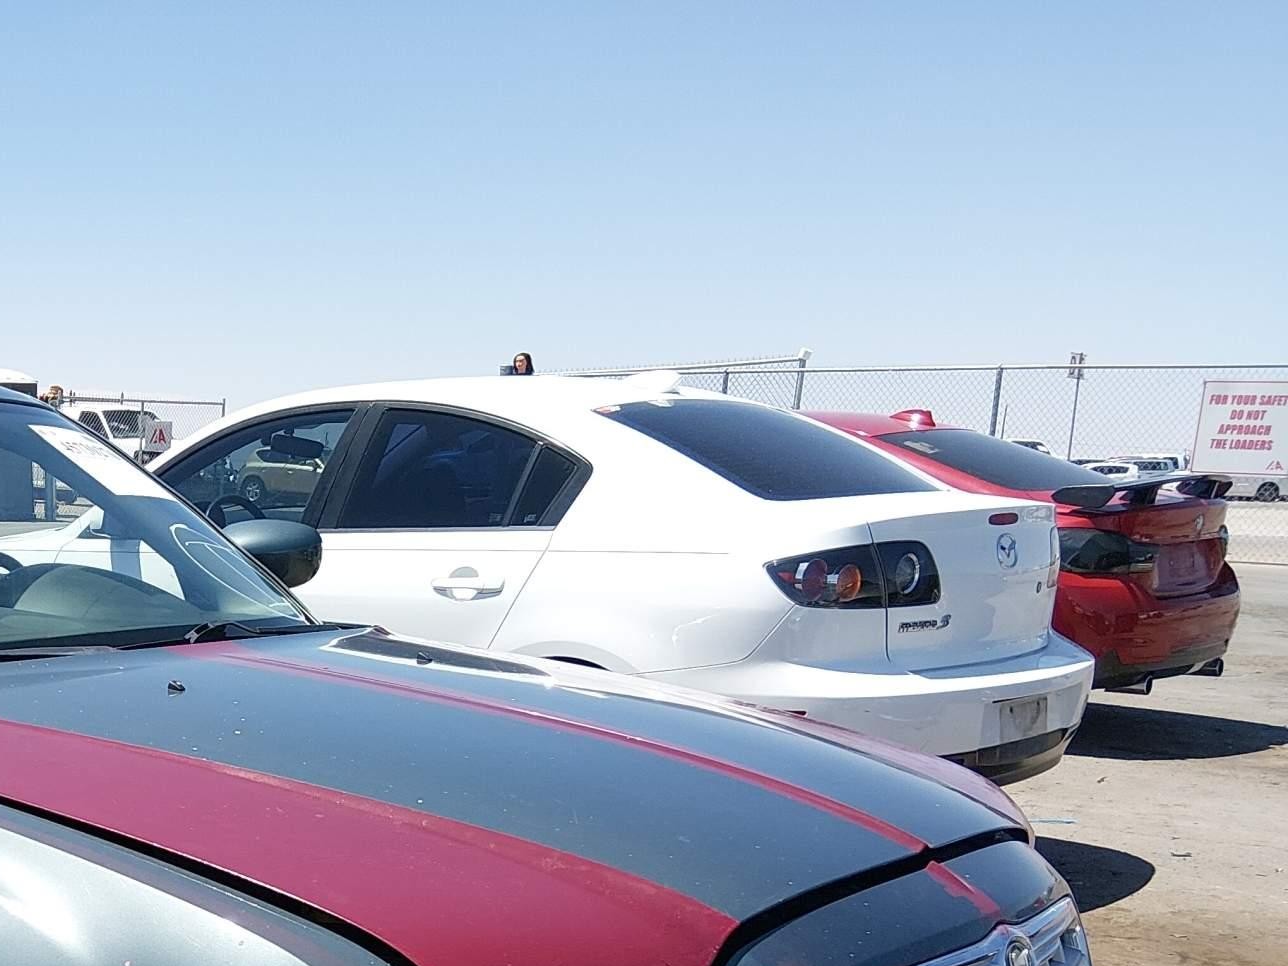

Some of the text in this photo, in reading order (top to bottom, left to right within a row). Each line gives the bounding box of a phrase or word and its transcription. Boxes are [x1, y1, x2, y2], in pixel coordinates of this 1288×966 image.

[1209, 394, 1288, 406] FOR YOUR SAFET
[1229, 409, 1267, 421] DO NOT
[1217, 424, 1272, 436] APPROACH
[1210, 439, 1274, 451] THE LOADERS
